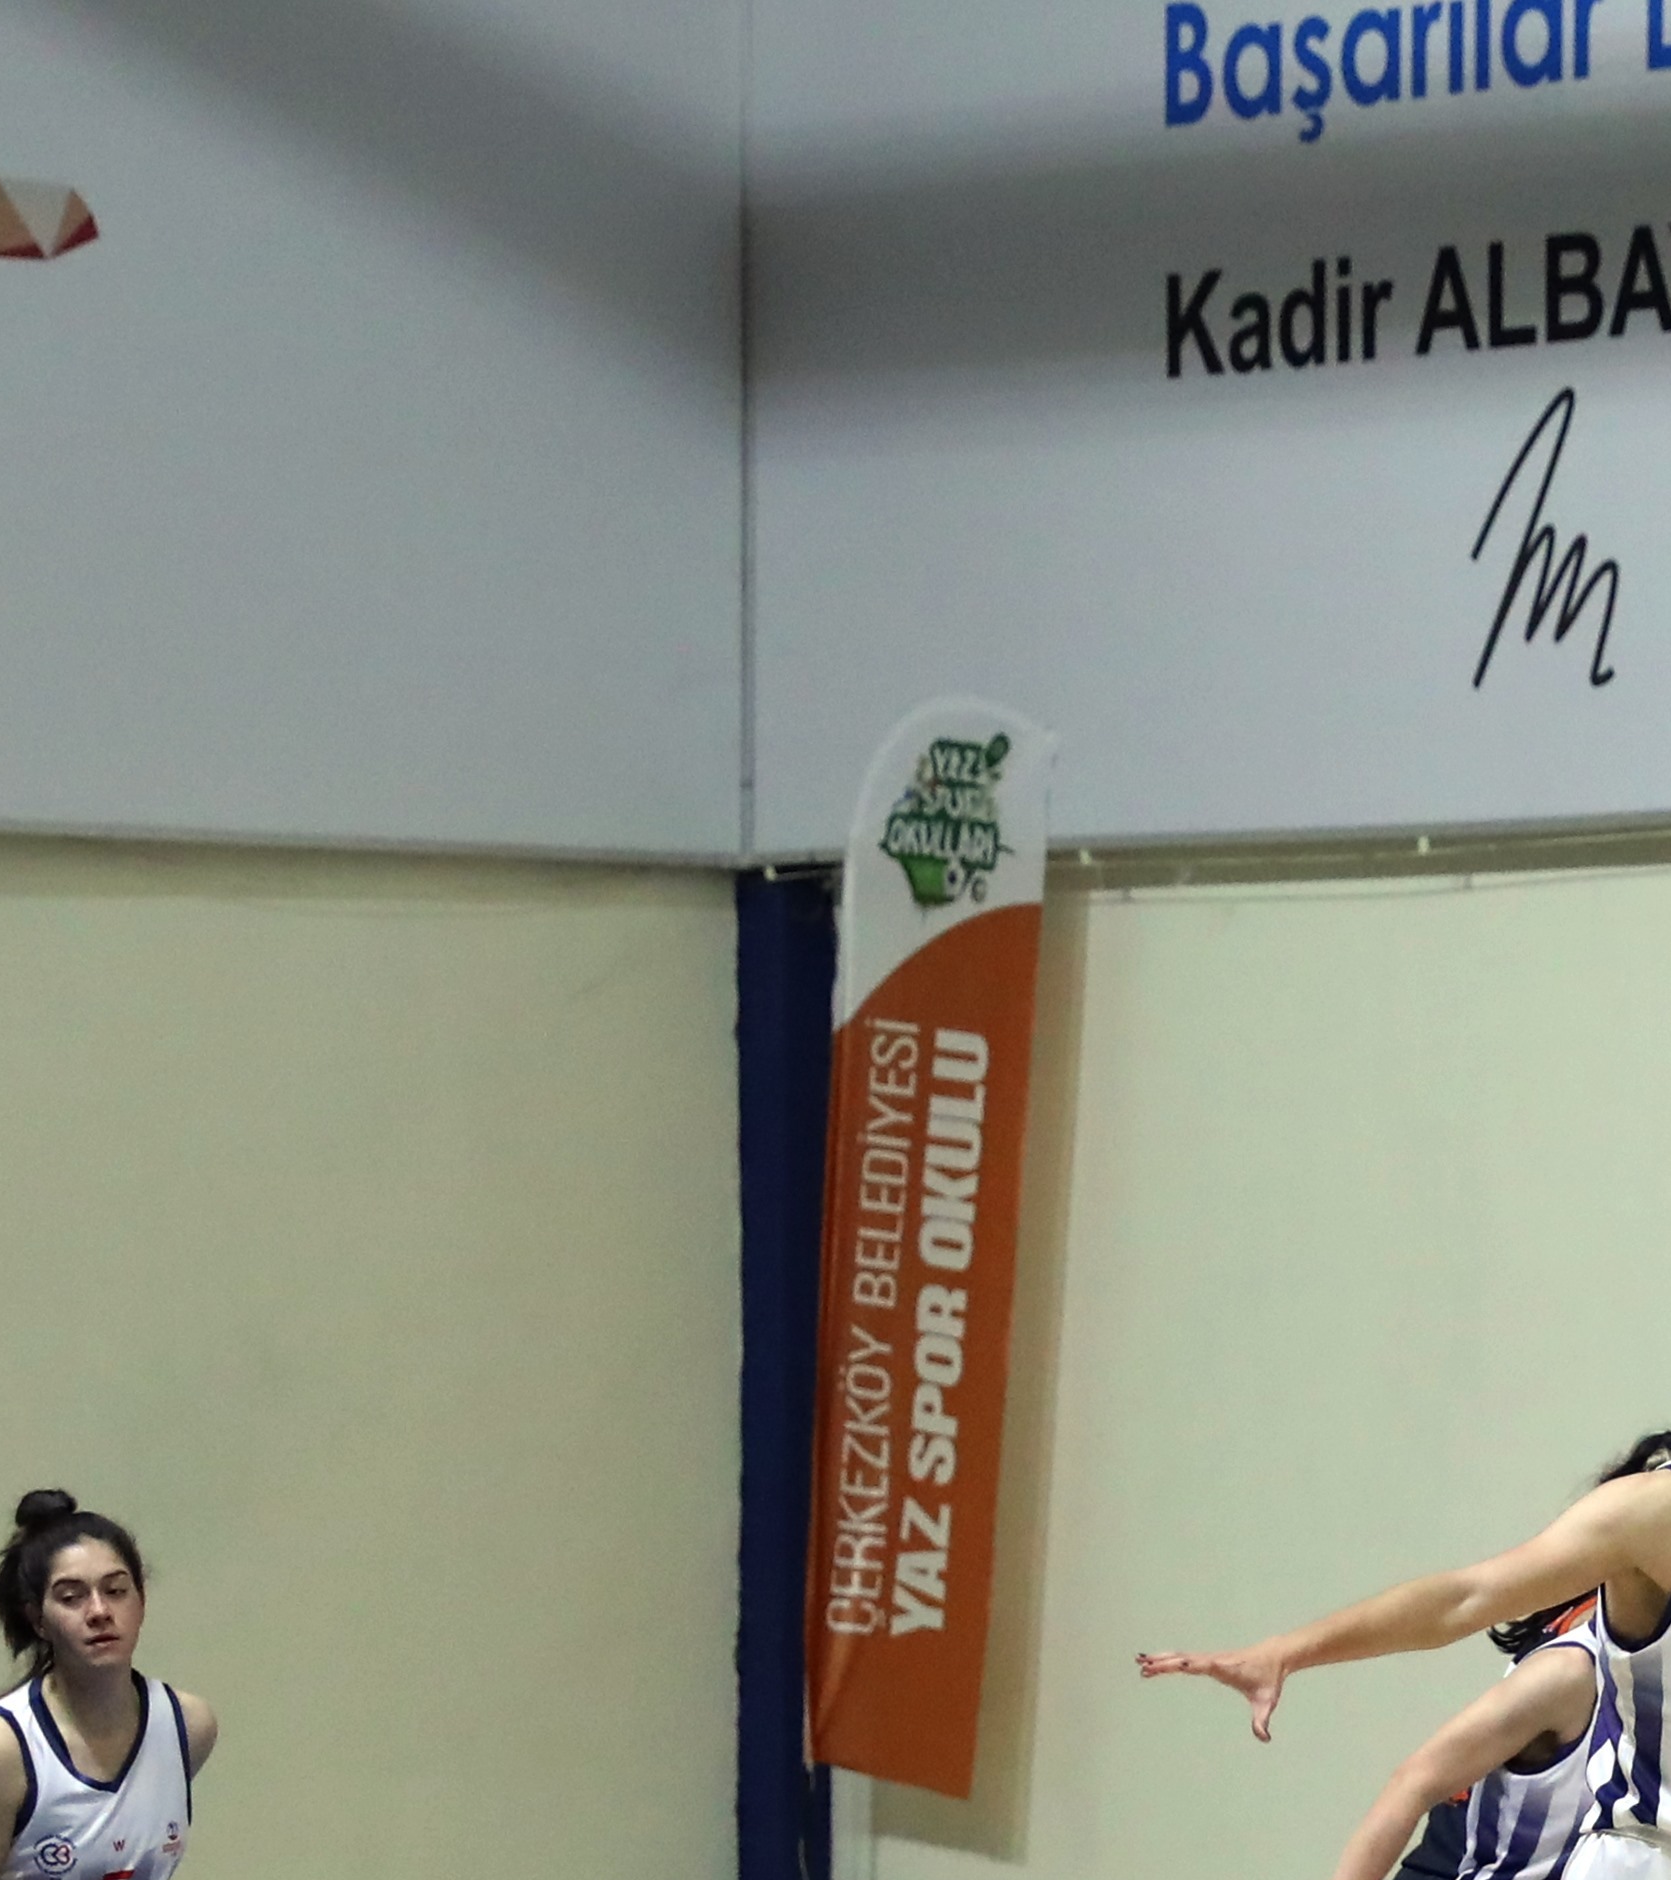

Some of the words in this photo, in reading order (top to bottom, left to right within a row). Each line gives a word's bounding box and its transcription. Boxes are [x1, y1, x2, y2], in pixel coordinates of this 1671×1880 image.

[1165, 0, 1601, 144] Başarılar
[1166, 256, 1394, 378] Kadir
[851, 1016, 922, 1310] BELEDİYESİ
[918, 1026, 990, 1273] OKULU
[826, 1324, 894, 1636] ÇERKEZKÖY
[907, 1283, 969, 1486] SPOR
[888, 1495, 953, 1638] YAZ
